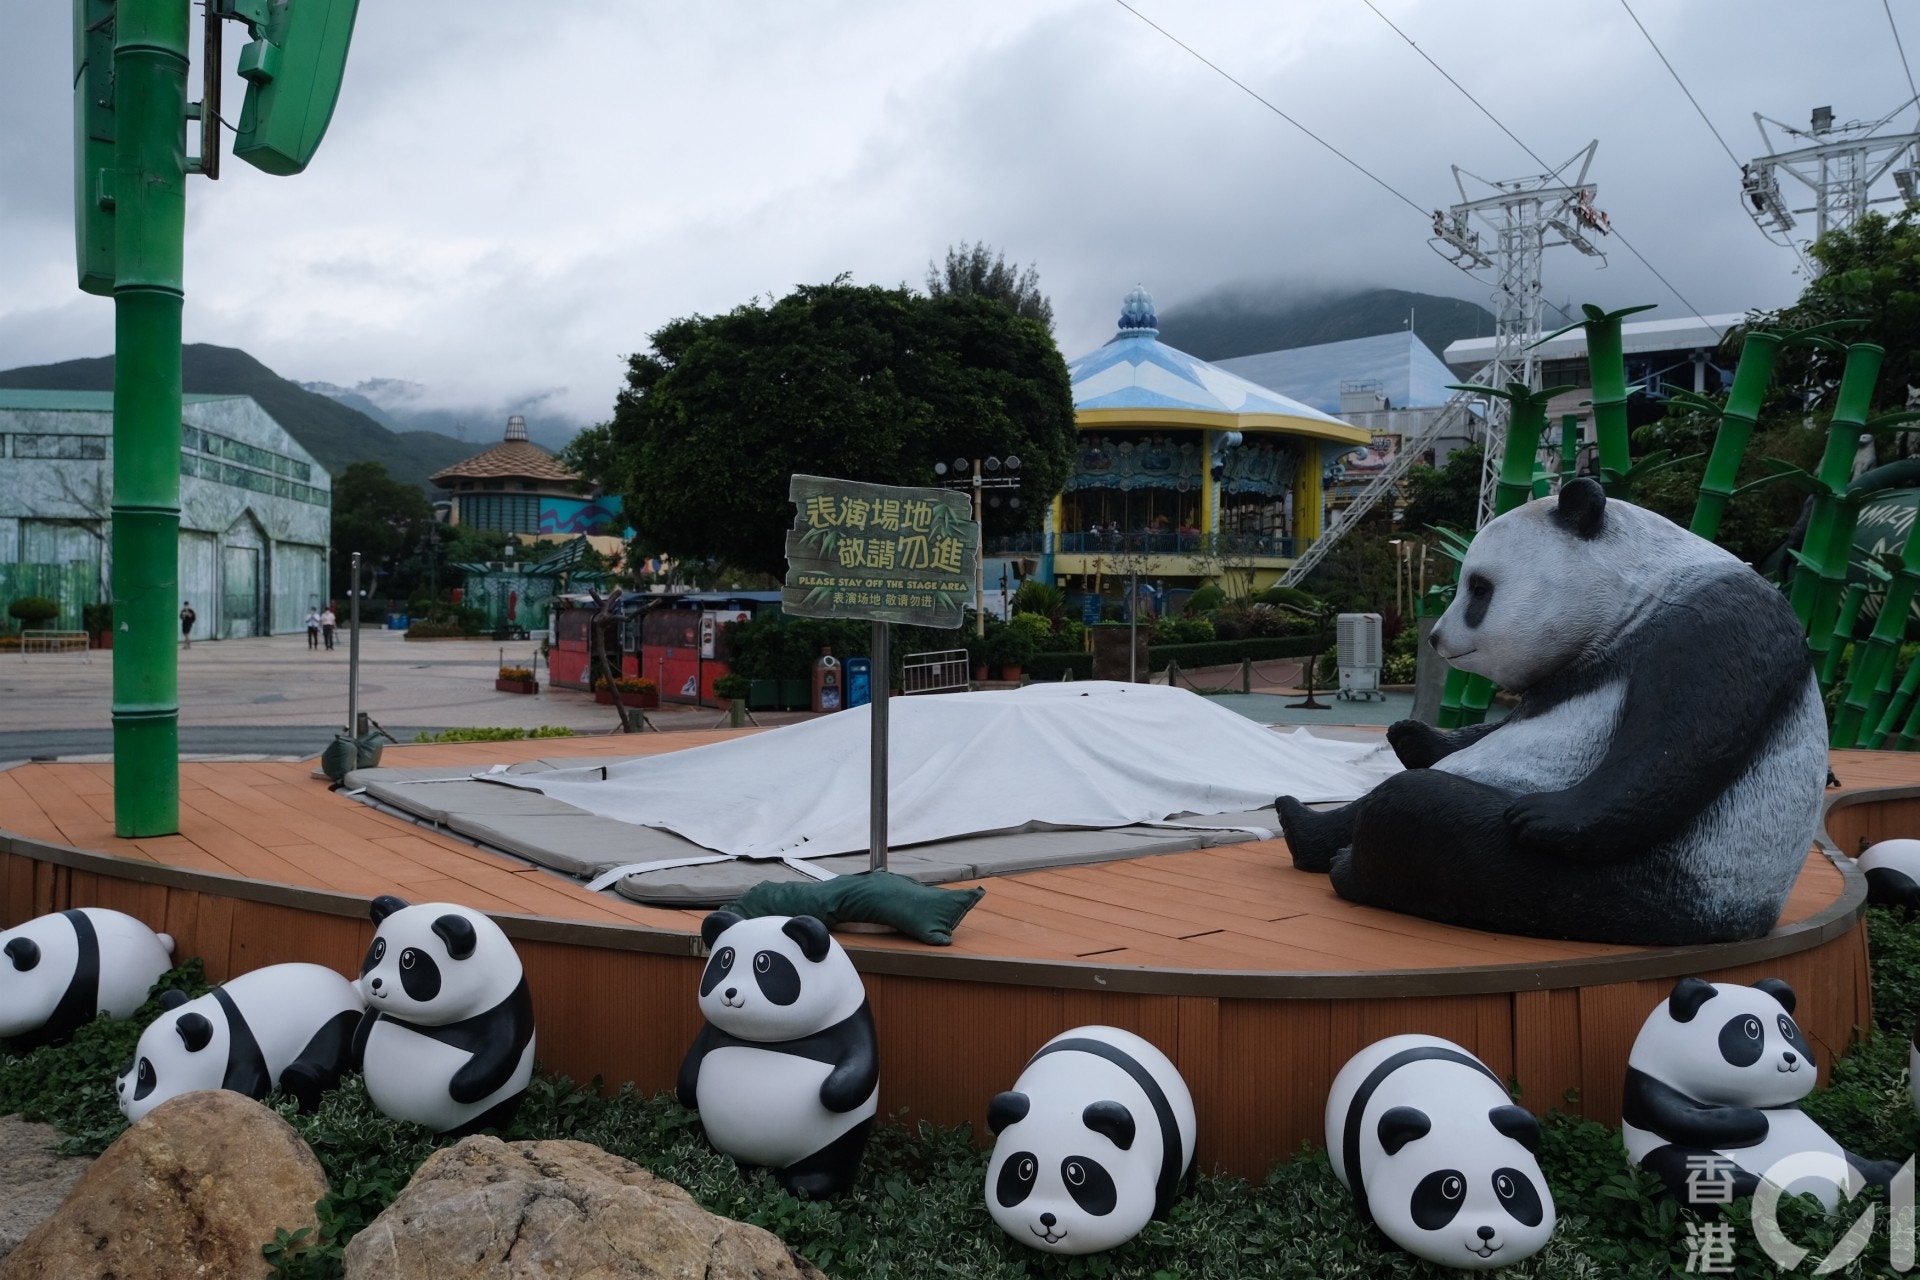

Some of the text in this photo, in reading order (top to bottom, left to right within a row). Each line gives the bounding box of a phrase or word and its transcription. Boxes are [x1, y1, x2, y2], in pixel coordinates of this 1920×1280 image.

[806, 496, 933, 533] 表演場地
[837, 535, 964, 574] 敬請勿進
[799, 576, 968, 591] PLEASE STAY OFF THE STAGE AREA
[833, 591, 933, 608] 表演场地 敬请勿进
